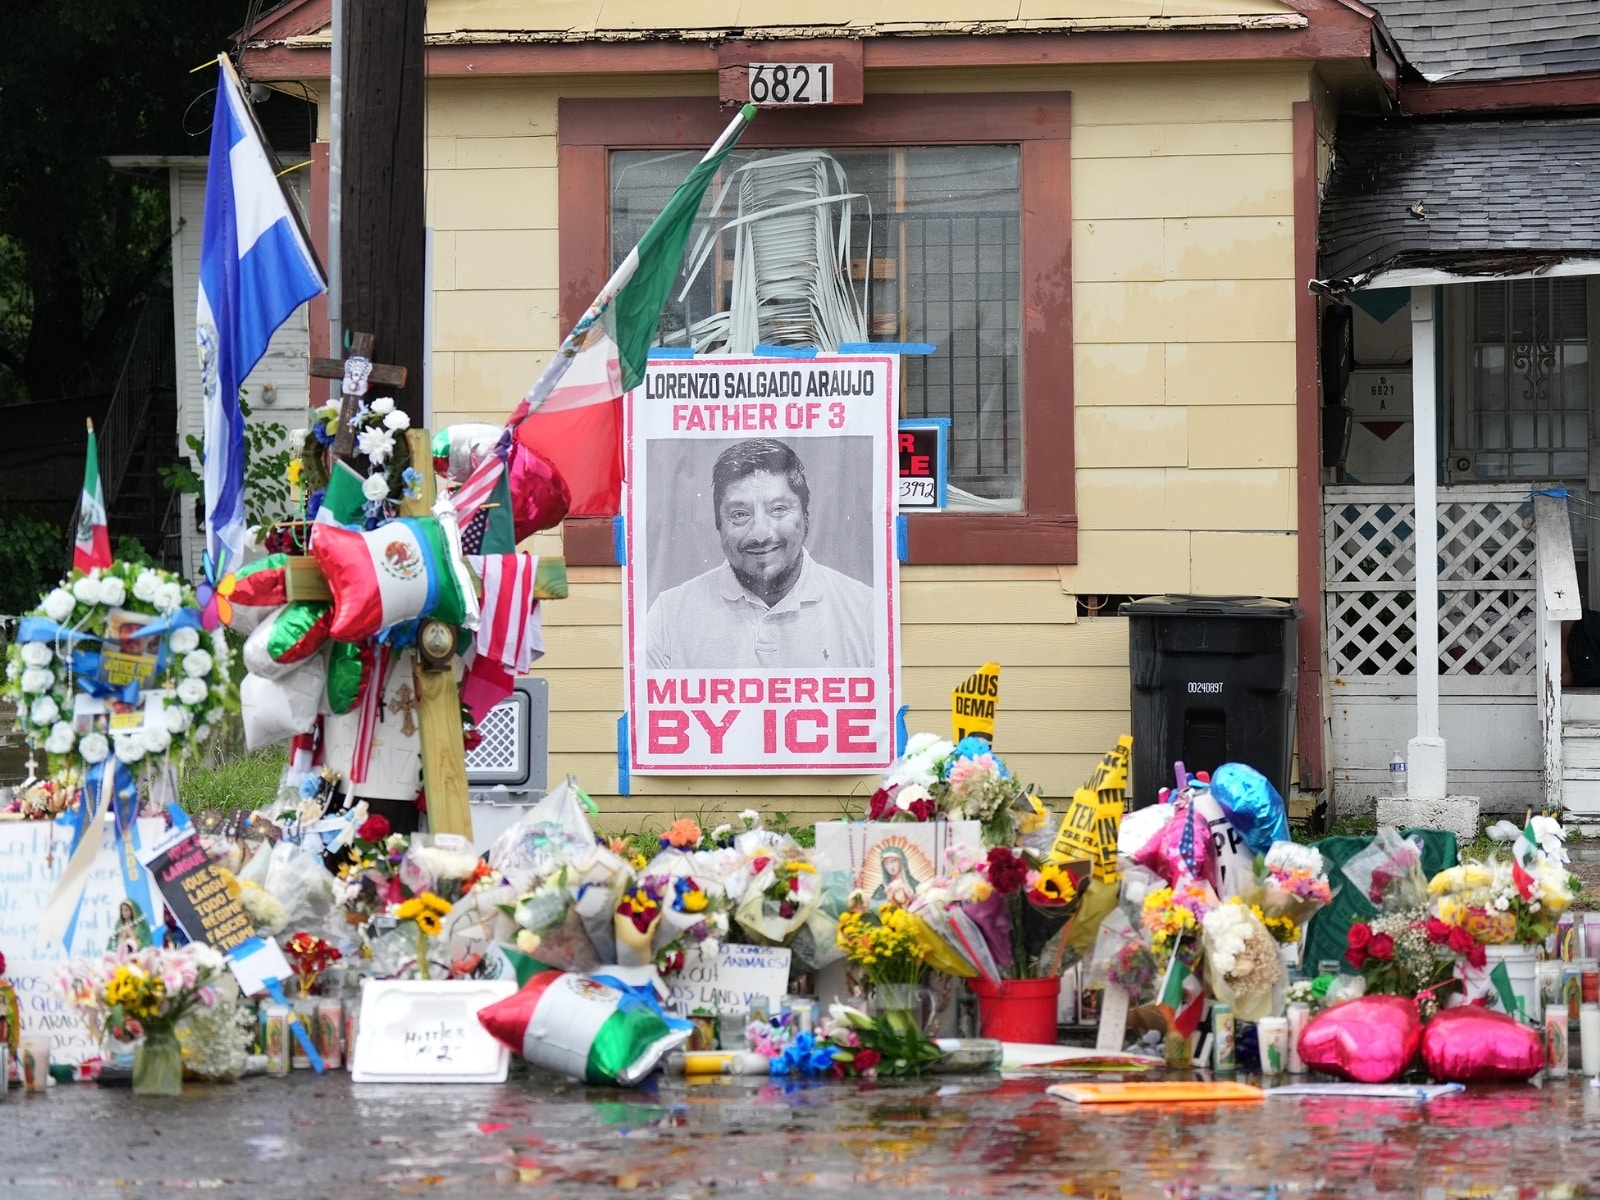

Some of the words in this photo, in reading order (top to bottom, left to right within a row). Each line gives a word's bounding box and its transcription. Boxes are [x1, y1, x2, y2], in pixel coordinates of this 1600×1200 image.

[750, 65, 828, 102] 6821
[646, 373, 719, 399] LORENZO
[724, 371, 801, 398] SALGADO
[806, 370, 874, 397] ARAUJO
[1371, 385, 1394, 396] 6821
[672, 404, 777, 431] FATHER
[785, 403, 822, 430] OF
[828, 402, 846, 429] 3
[1380, 399, 1386, 410] A
[646, 677, 875, 704] MURDERED
[1187, 682, 1224, 693] 00240897
[956, 696, 995, 719] DEMA
[648, 710, 742, 754] BY
[763, 709, 877, 753] ICE
[187, 877, 228, 906] LARGU
